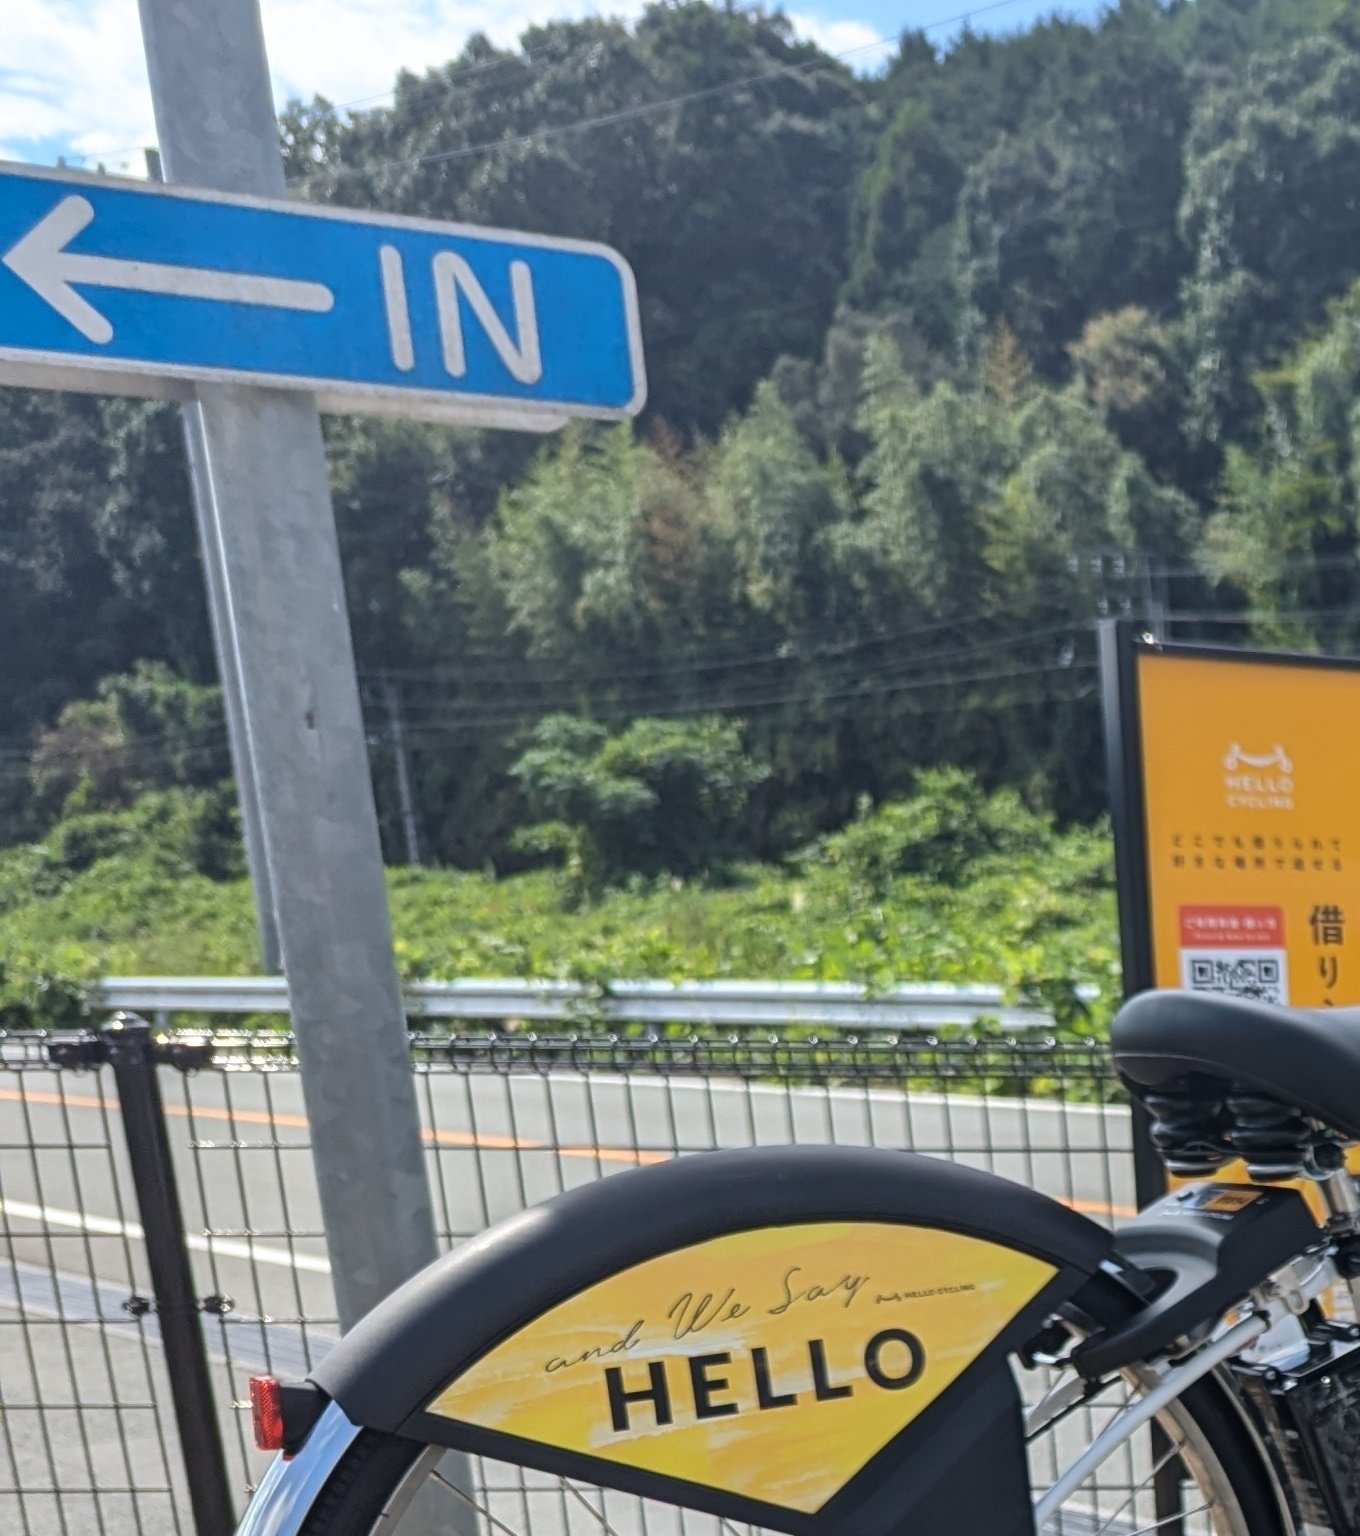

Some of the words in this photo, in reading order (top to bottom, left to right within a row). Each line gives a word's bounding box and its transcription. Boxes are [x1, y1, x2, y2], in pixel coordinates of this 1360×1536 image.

[379, 244, 542, 384] IN
[1224, 775, 1294, 793] HELLO
[1308, 904, 1346, 1006] 借り
[545, 1320, 643, 1373] and
[668, 1288, 751, 1340] We
[767, 1267, 870, 1315] Say
[604, 1328, 926, 1432] HELLO
